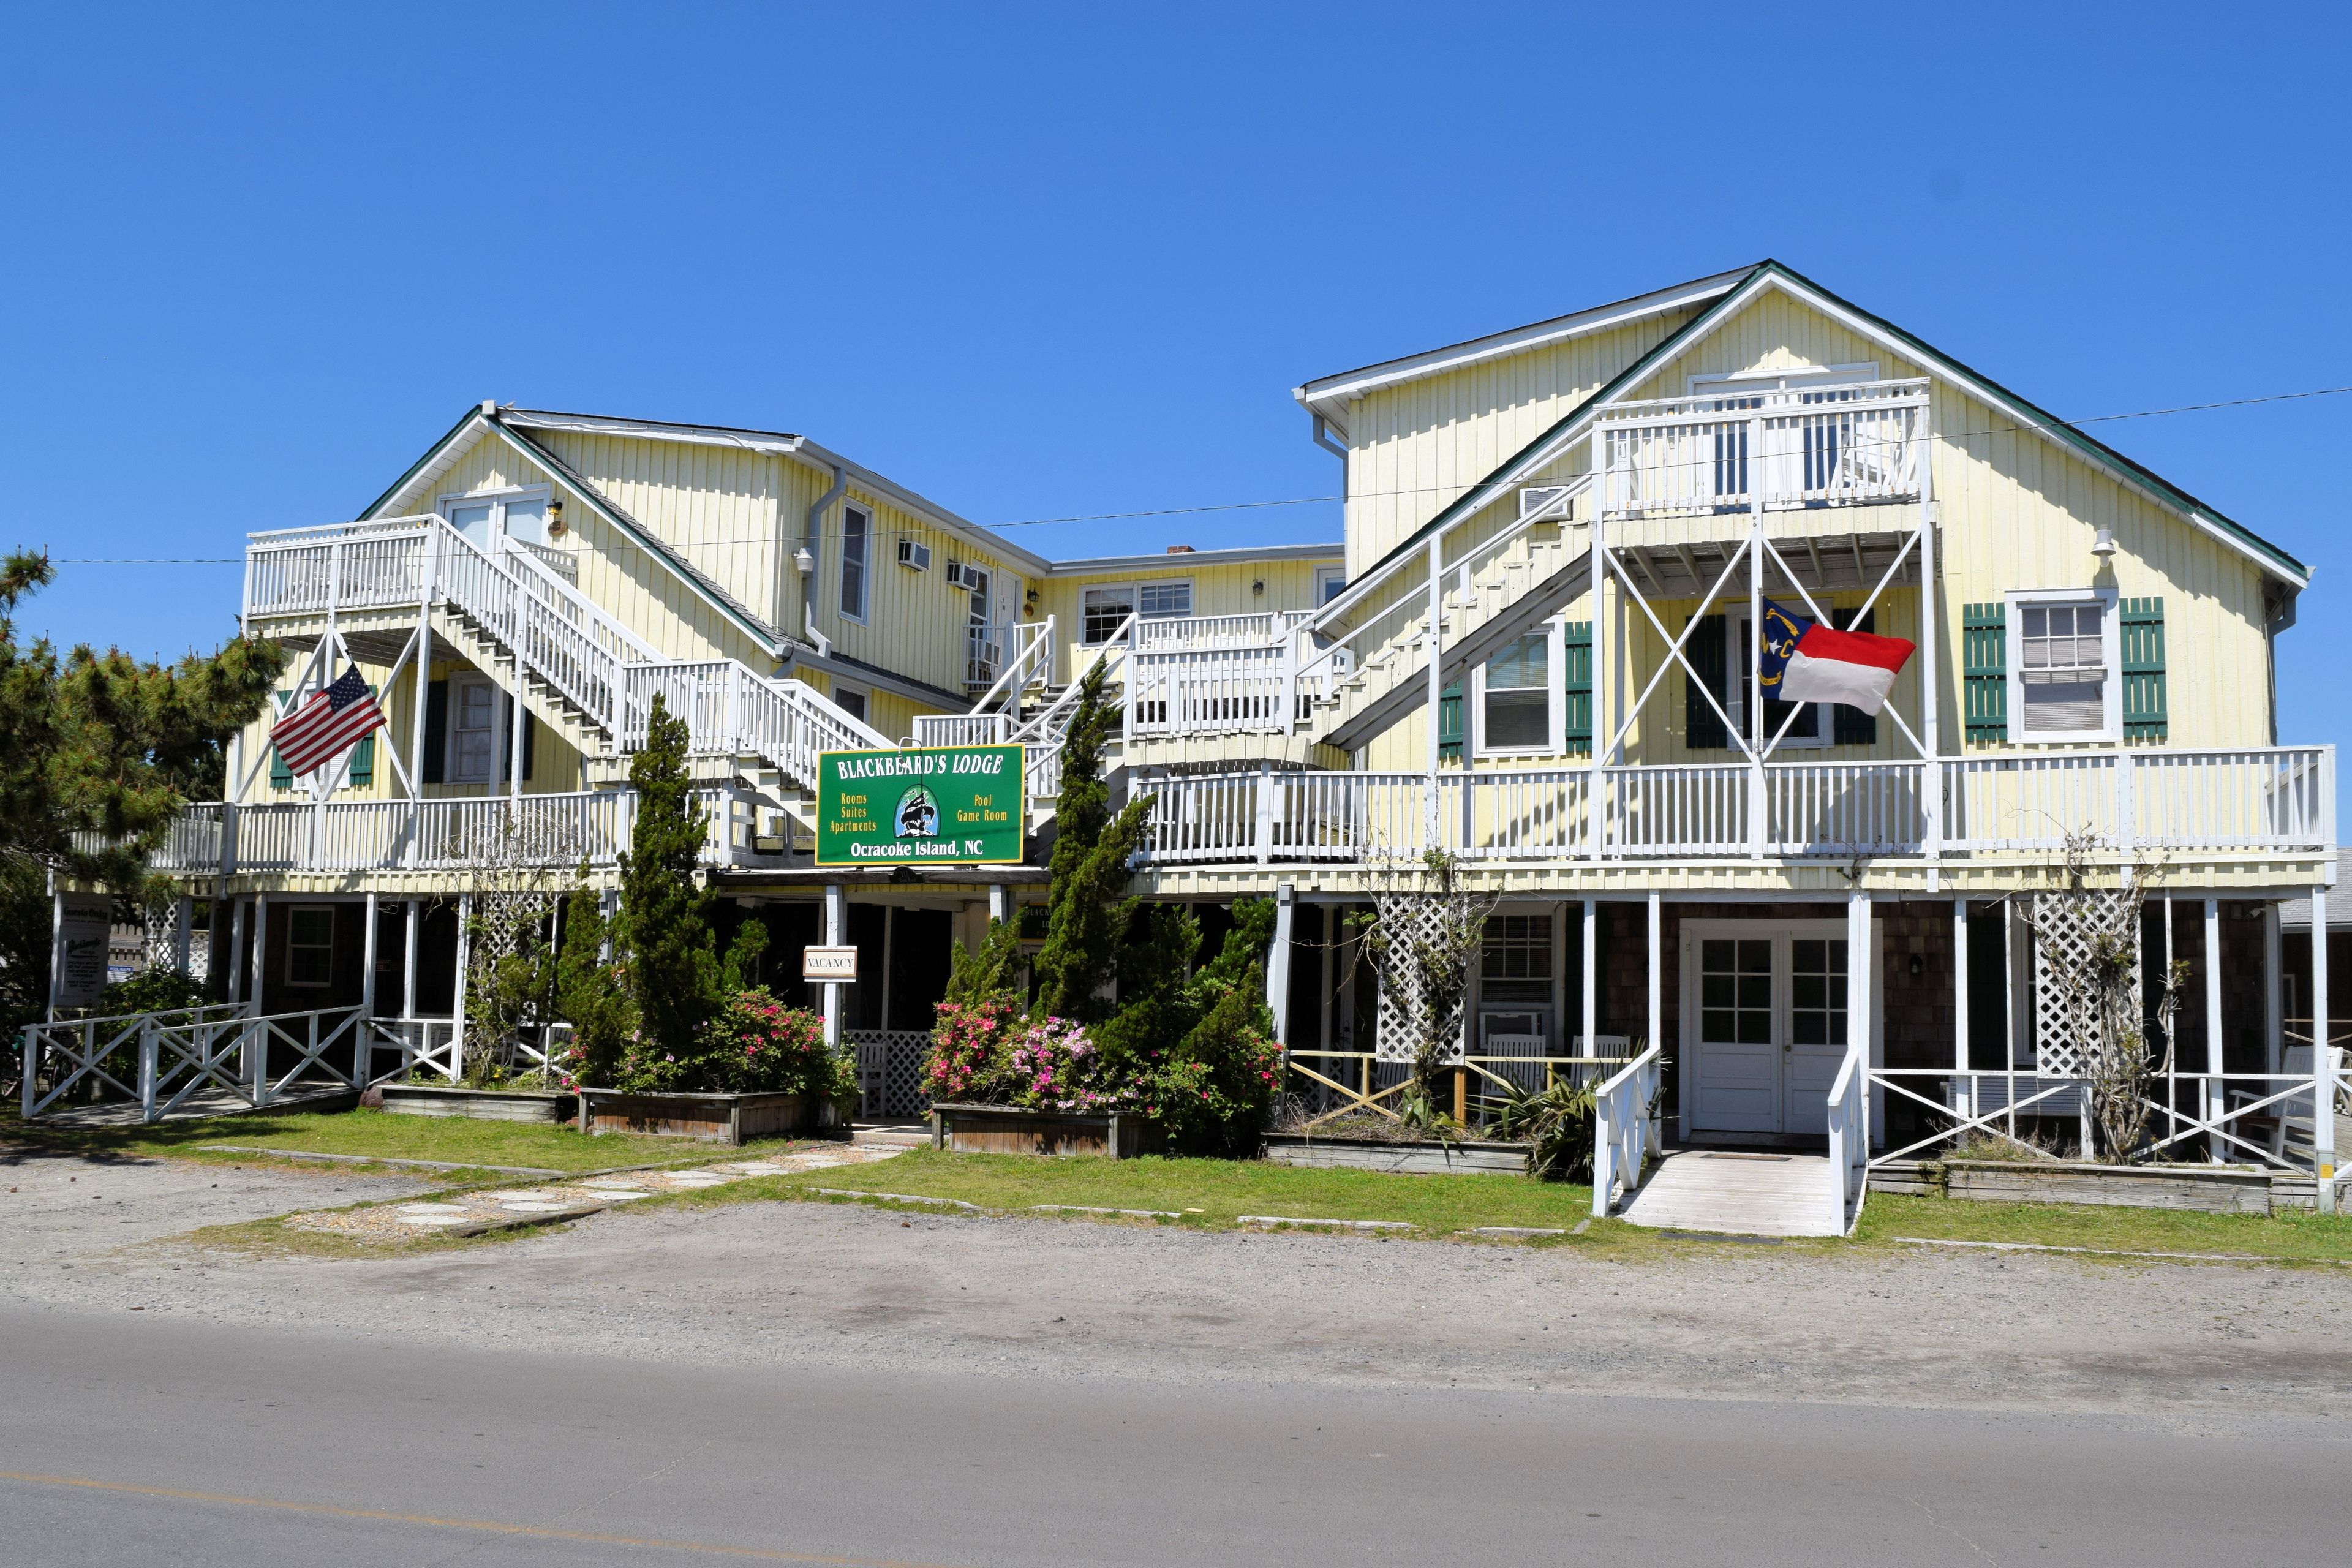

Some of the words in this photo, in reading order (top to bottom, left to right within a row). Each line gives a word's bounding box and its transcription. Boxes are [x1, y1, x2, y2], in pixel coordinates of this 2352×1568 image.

[1779, 639, 1793, 658] C
[837, 755, 946, 780] BLACKBEARD'S
[952, 754, 1003, 774] LODGE
[841, 793, 867, 804] Rooms
[974, 794, 992, 806] Pool
[841, 805, 867, 818] Suites
[957, 809, 979, 821] Game
[984, 809, 1007, 821] Room
[829, 820, 876, 835] Apartments
[851, 842, 911, 856] Ocracoke
[915, 840, 960, 856] Island,
[965, 840, 983, 854] NC
[807, 958, 854, 968] VACANCY
